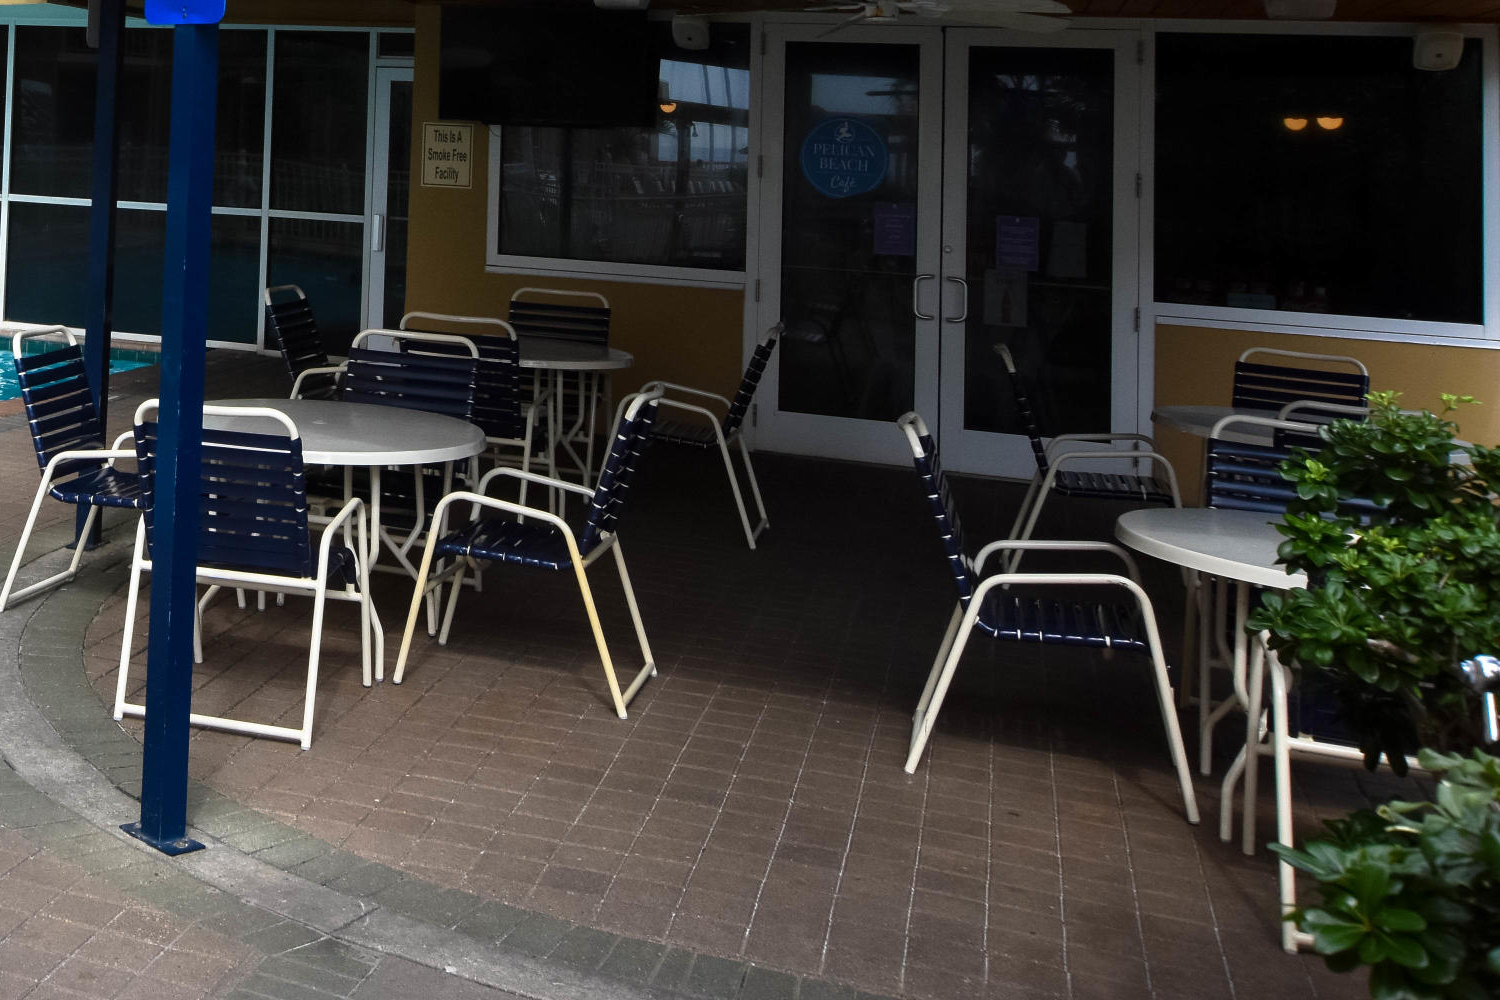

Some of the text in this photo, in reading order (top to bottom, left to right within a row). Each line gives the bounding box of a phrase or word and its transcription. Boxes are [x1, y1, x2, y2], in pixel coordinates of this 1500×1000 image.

[434, 130, 462, 143] This Is A
[428, 148, 467, 162] Smoke Free
[813, 143, 875, 157] PELICAN
[819, 157, 868, 172] BEACH
[435, 166, 459, 183] Facility
